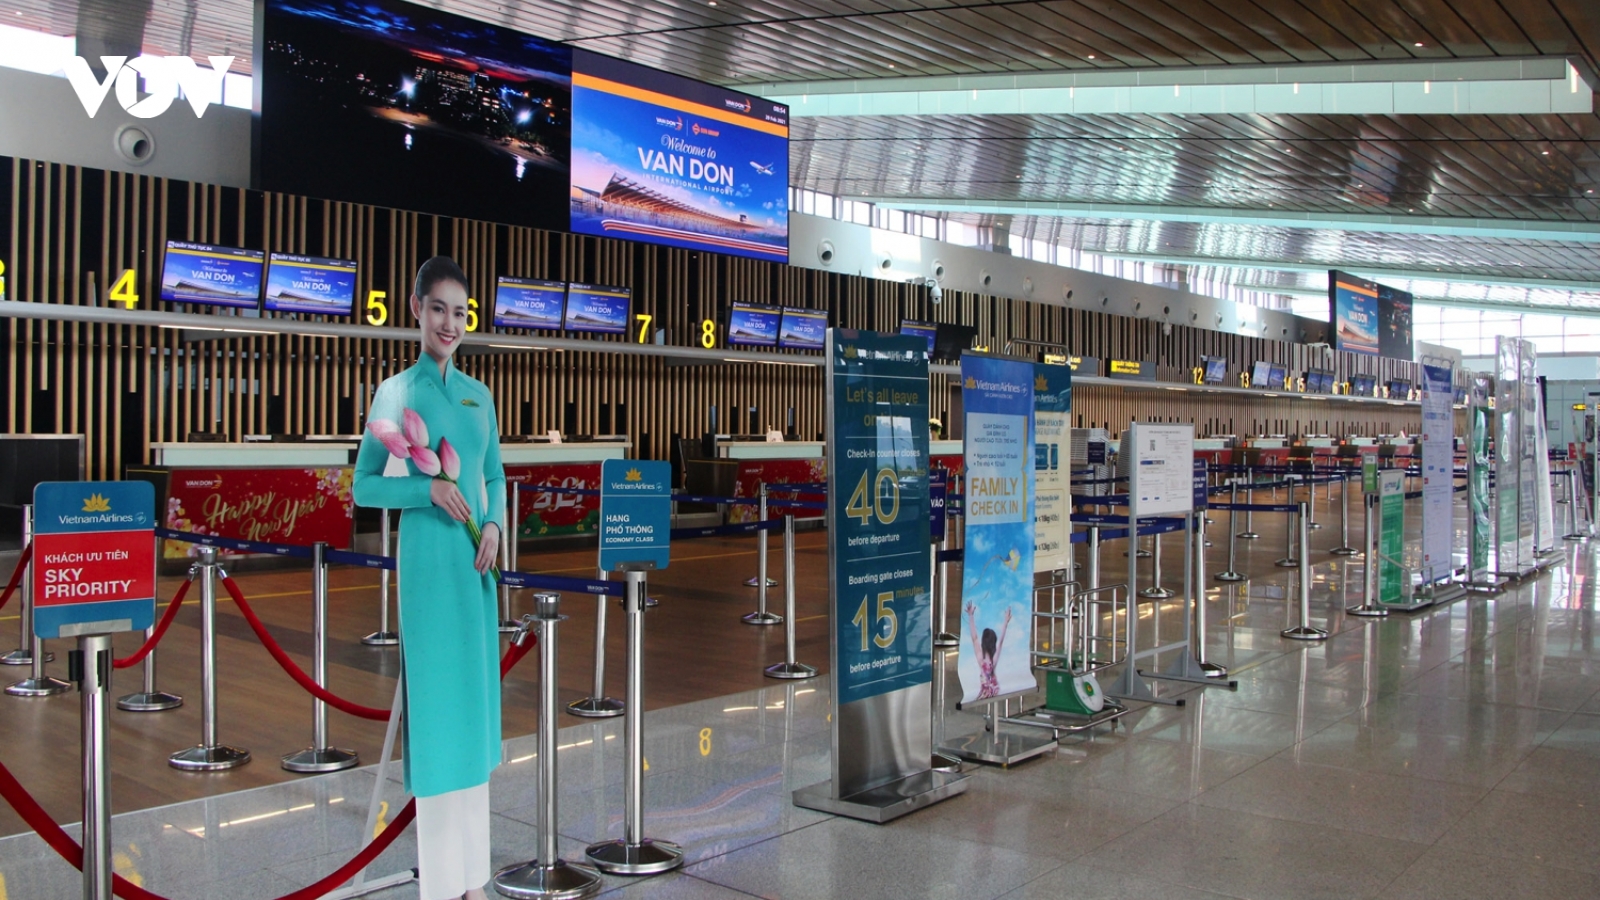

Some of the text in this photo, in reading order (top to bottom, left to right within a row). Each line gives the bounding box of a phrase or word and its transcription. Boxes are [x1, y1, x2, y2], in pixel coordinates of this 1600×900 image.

[661, 134, 717, 160] Welcome to
[637, 147, 733, 187] VAN DON
[642, 173, 734, 197] INTERNATIONAL AIRPORT
[191, 270, 236, 282] VAN DON
[109, 269, 139, 309] 4
[292, 280, 331, 292] VAN DON
[366, 290, 388, 326] 5
[465, 298, 479, 332] 6
[636, 313, 652, 343] 7
[702, 319, 715, 349] 8
[1193, 367, 1203, 385] 12
[1240, 372, 1250, 388] 13
[846, 386, 918, 404] Let's all leave
[877, 449, 900, 458] counter
[900, 449, 921, 458] closes
[611, 482, 655, 490] Vietnam Airlines
[970, 477, 1018, 497] FAMILY
[845, 467, 900, 526] 40
[202, 490, 328, 538] Happy Year
[970, 500, 1018, 516] CHECK IN
[58, 514, 133, 525] Vietnam Airlines
[606, 514, 630, 525] HẠNG
[606, 523, 654, 534] PHỔ THÔNG
[239, 515, 282, 543] New
[848, 534, 900, 546] before departure
[44, 549, 129, 564] KHÁCH ƯU TIÊN
[45, 567, 84, 583] SKY
[848, 568, 914, 585] Boarding gate closes
[45, 580, 132, 599] PRIORITY
[896, 586, 924, 598] minutes
[851, 591, 898, 652] 15
[849, 655, 902, 674] before departure
